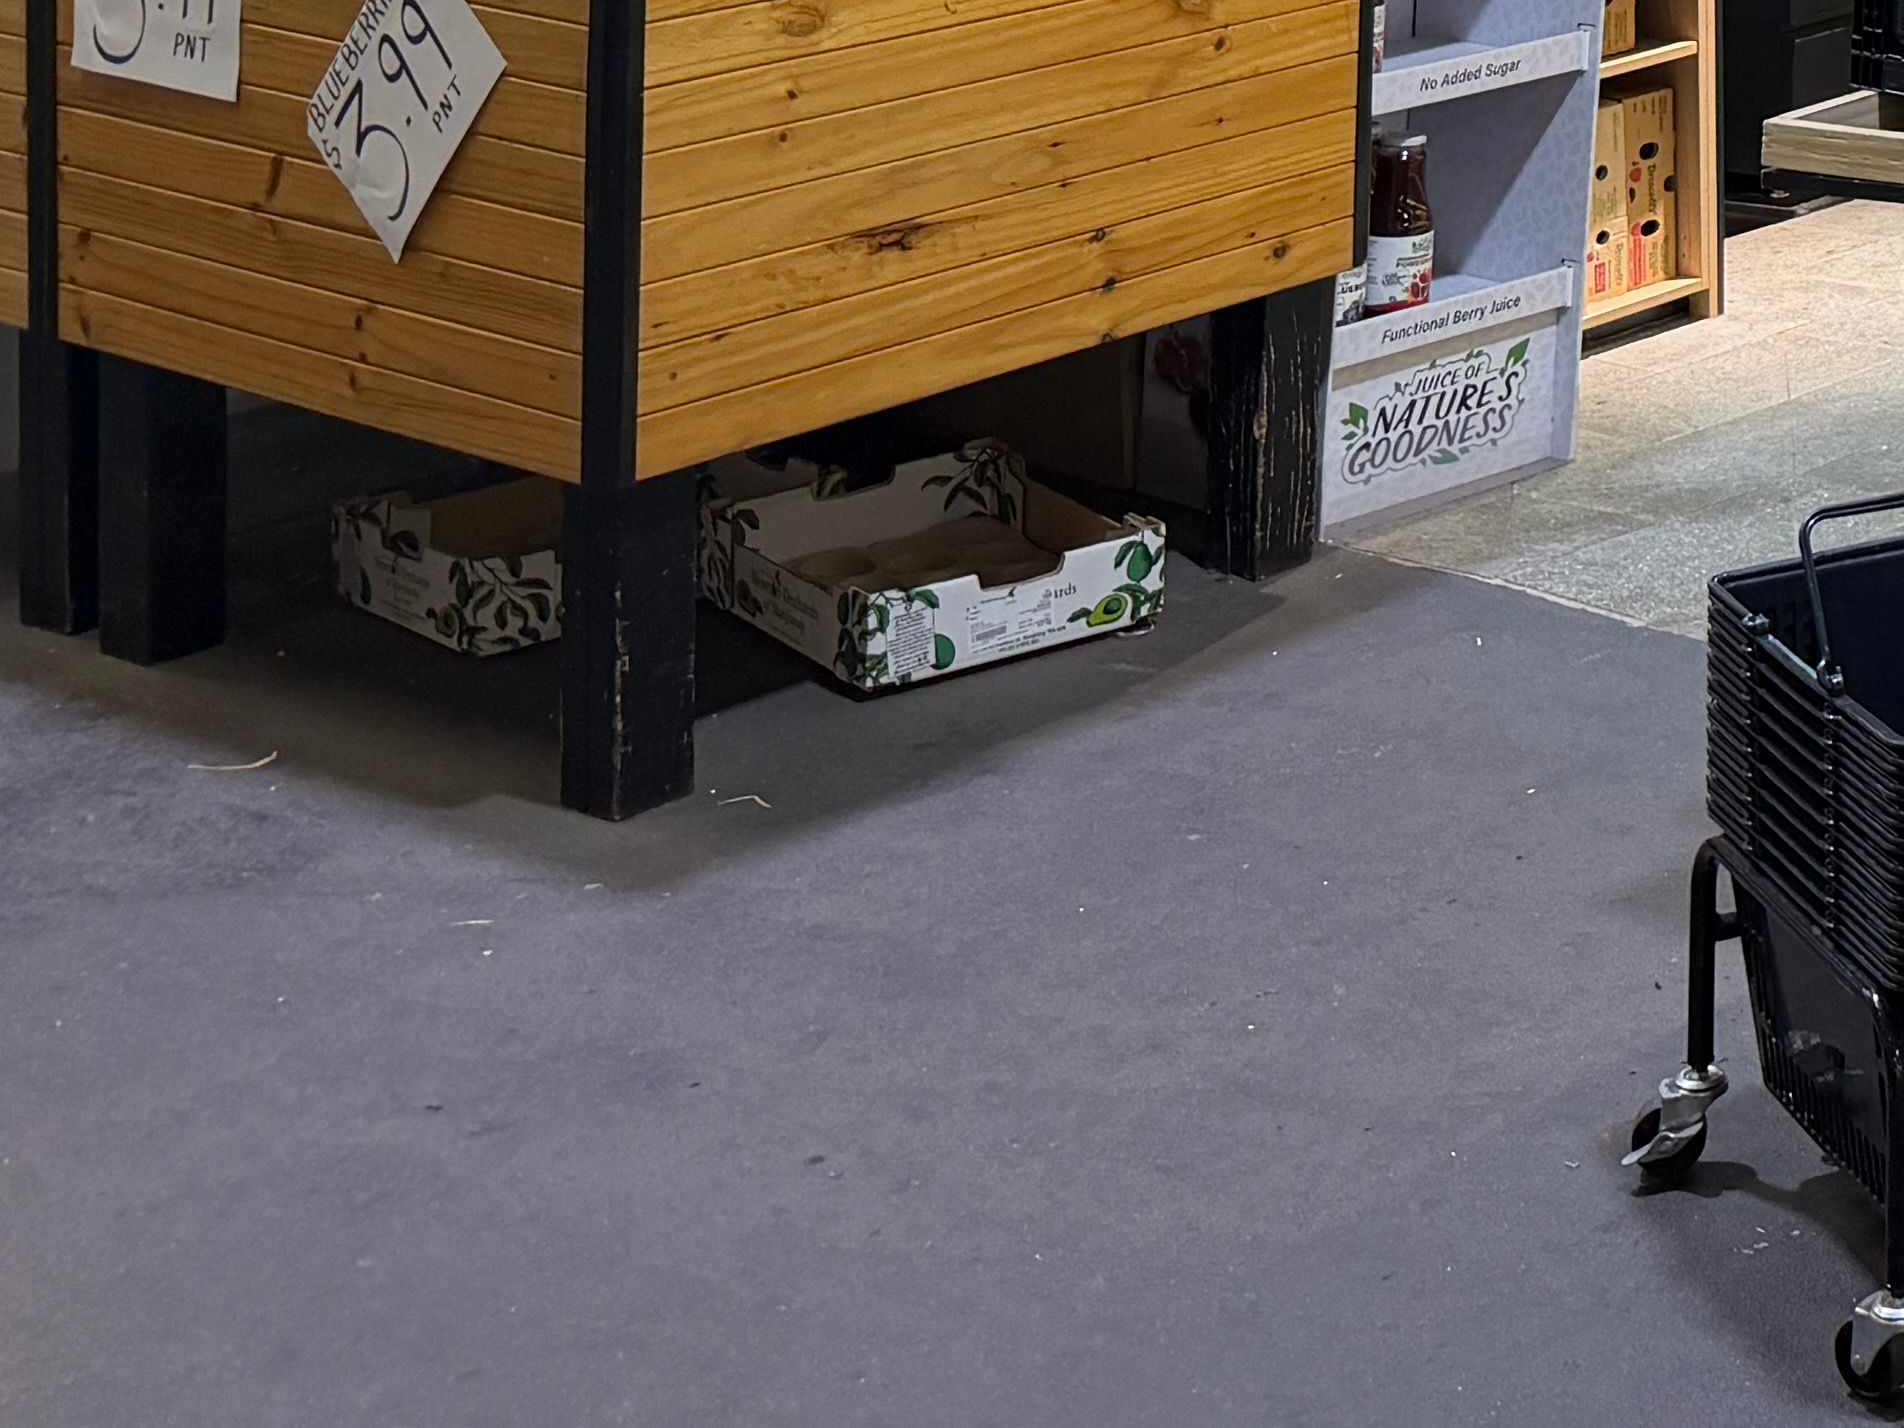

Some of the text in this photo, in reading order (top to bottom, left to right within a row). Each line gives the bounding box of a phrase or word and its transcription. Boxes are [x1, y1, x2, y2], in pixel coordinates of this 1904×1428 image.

[173, 32, 212, 63] PNT
[1420, 59, 1522, 92] No Added Sugar
[432, 75, 464, 133] PNT
[1381, 295, 1522, 345] Functional Berry Juice
[1412, 360, 1486, 396] JUICE OF
[1348, 403, 1512, 477] GOODNESS
